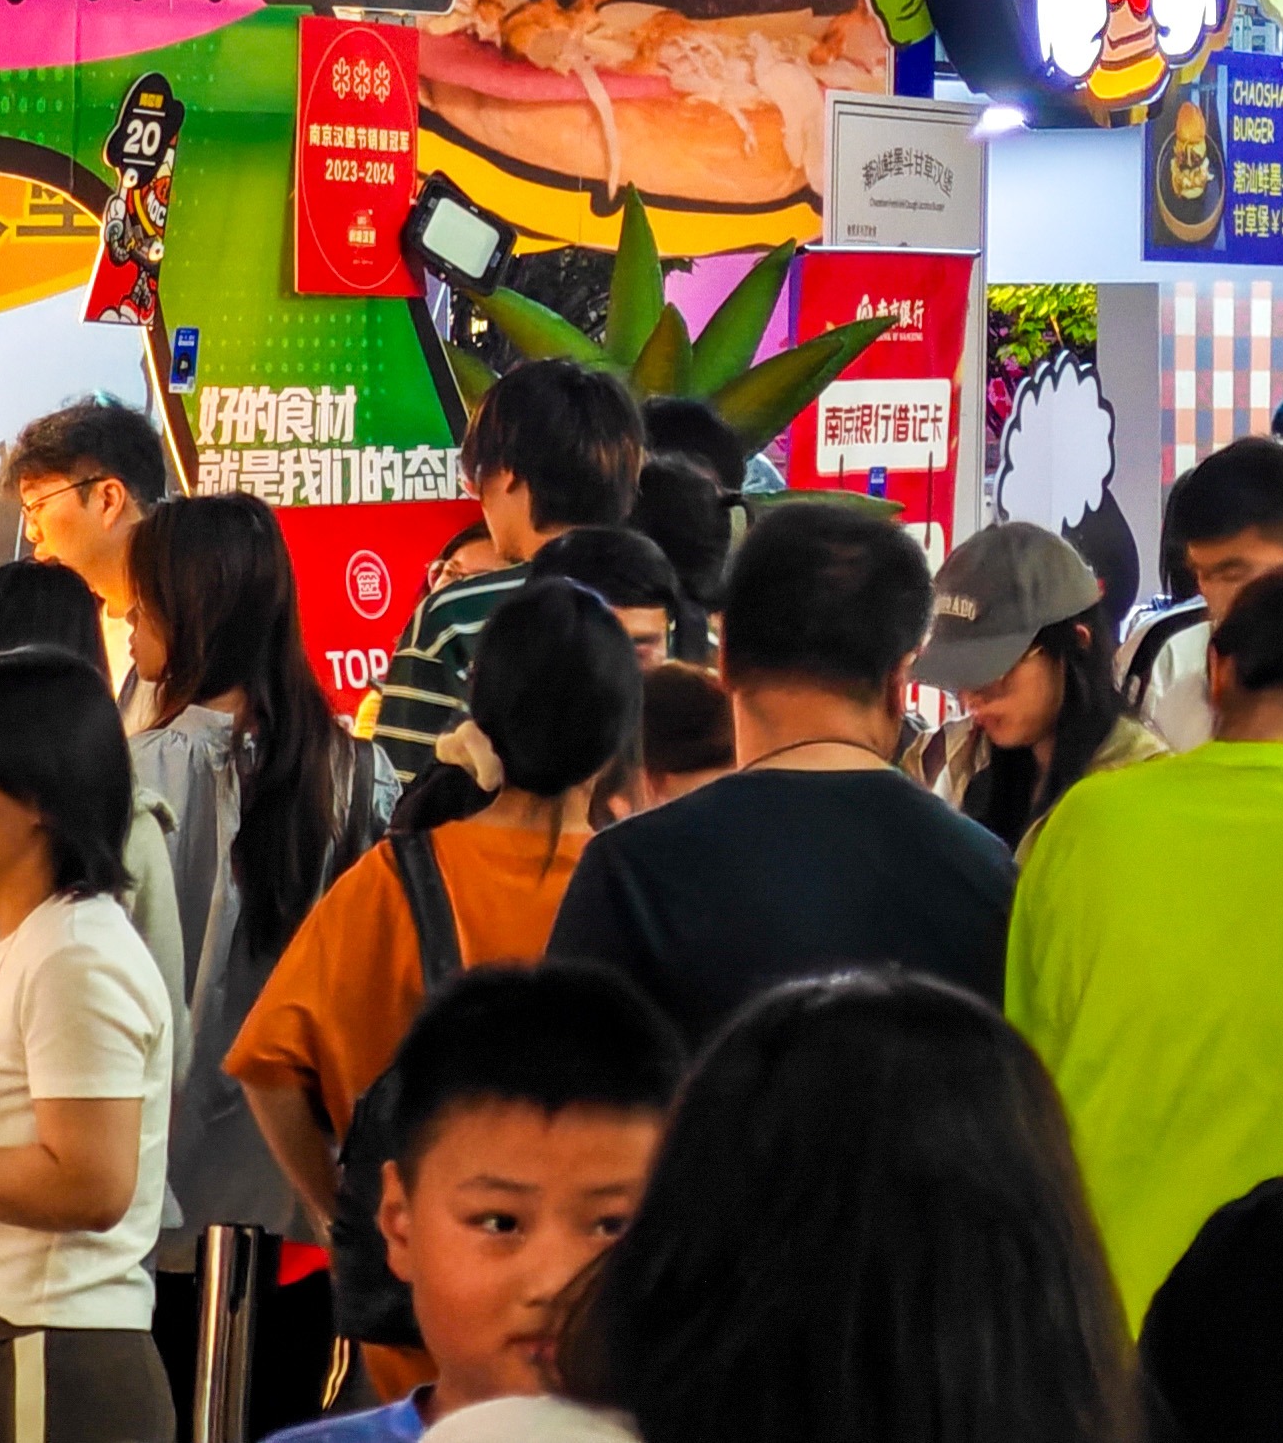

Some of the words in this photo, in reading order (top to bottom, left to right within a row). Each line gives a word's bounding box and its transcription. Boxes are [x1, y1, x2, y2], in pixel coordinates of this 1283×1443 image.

[123, 119, 163, 157] 20
[308, 123, 411, 153] 南京汉堡节销量冠军
[1232, 115, 1275, 145] BURGER
[324, 158, 396, 186] 2023-2024
[196, 385, 357, 446] 好的食材
[824, 404, 943, 447] 南京银行借记卡
